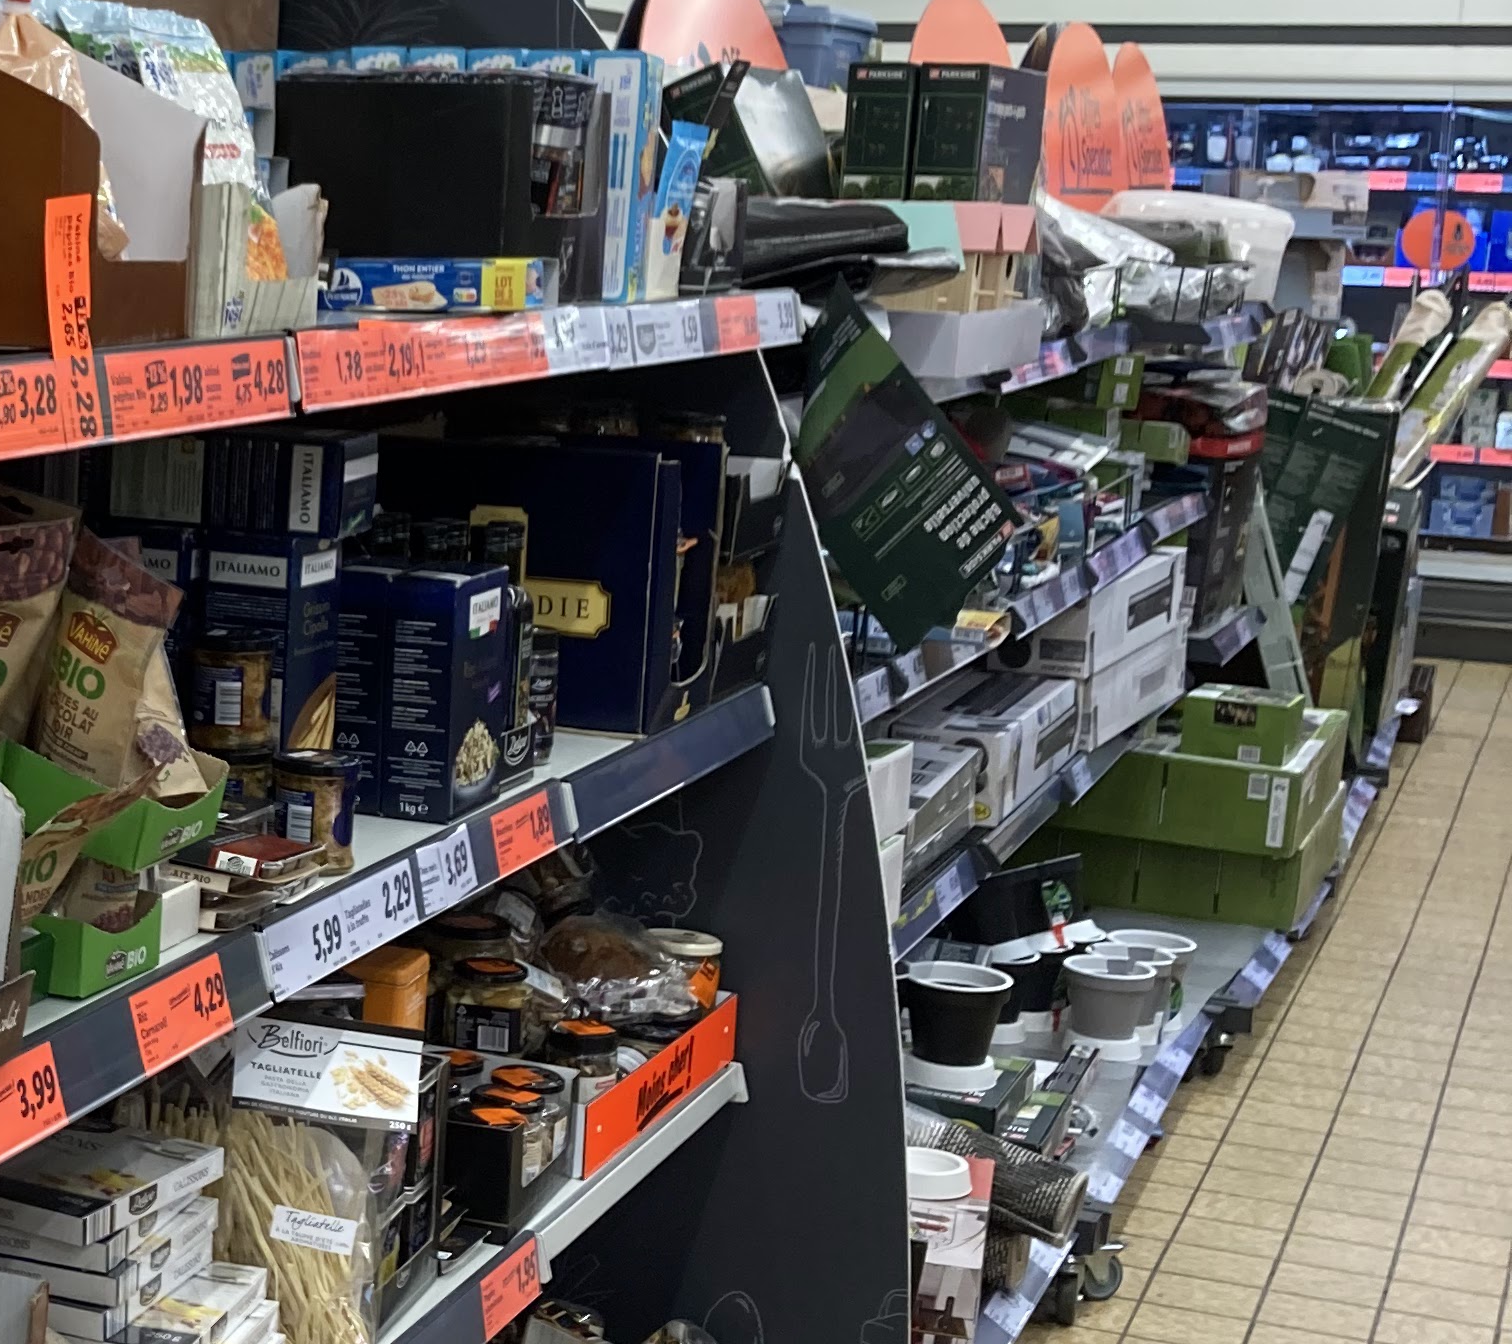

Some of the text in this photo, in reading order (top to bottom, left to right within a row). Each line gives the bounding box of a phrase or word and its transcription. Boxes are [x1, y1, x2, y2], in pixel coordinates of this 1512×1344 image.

[18, 372, 58, 420] 3,28
[70, 354, 98, 440] 2,28
[169, 363, 204, 408] 1,98
[253, 357, 285, 399] 4,28
[298, 452, 313, 525] ITALIAMO
[215, 561, 281, 579] ITALIAMO
[55, 645, 106, 700] BIO
[444, 840, 469, 888] 3,69
[382, 869, 412, 921] 2,29
[312, 914, 343, 963] 5,99
[192, 976, 226, 1021] 4,29
[258, 1023, 326, 1054] Belfiori
[16, 1063, 57, 1120] 3,99
[250, 1060, 322, 1080] TAGLIATELLE
